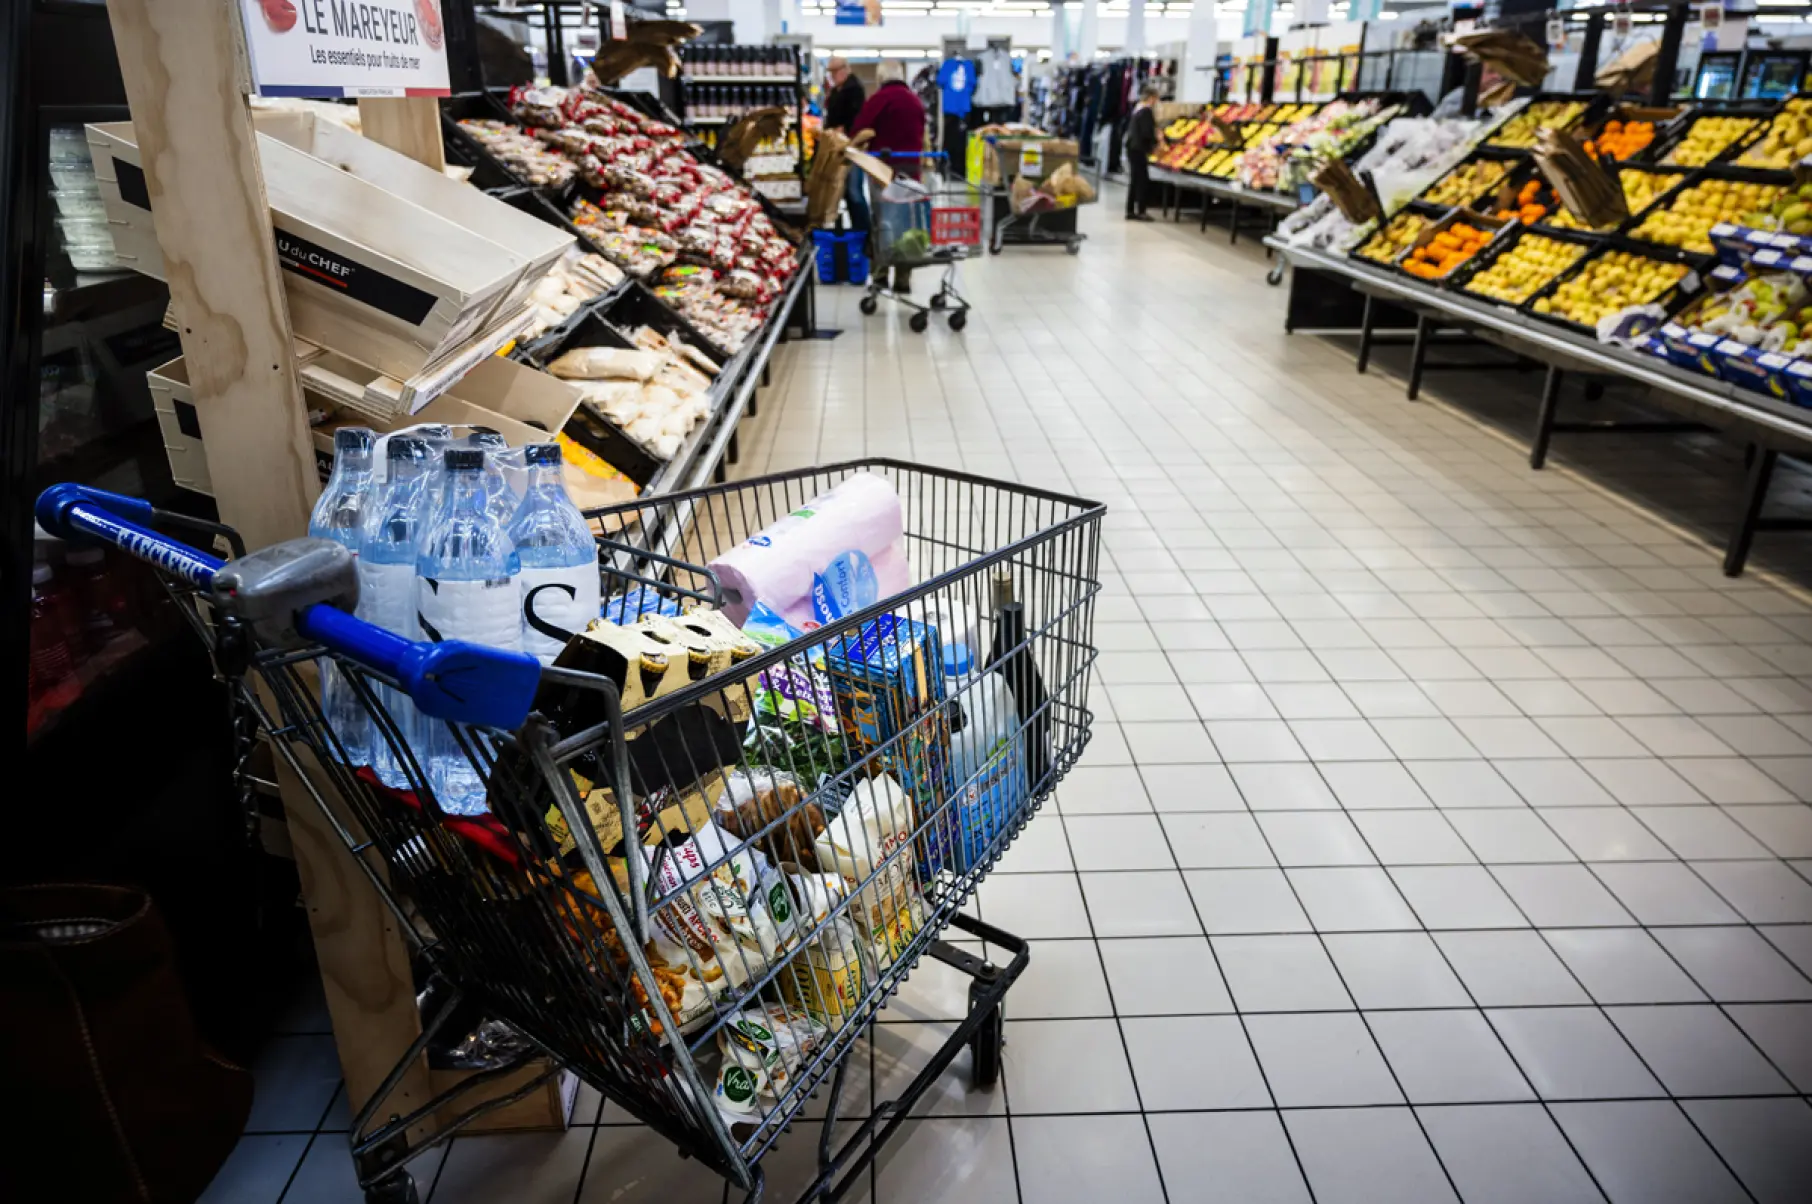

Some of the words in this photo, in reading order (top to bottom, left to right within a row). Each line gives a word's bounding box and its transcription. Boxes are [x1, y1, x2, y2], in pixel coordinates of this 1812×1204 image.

[302, 0, 328, 35] LE
[332, 0, 419, 46] MAREYEUR
[310, 45, 327, 64] Les
[328, 47, 366, 67] essentiels
[367, 53, 383, 71] pour
[384, 52, 400, 69] fruits
[401, 55, 409, 69] de
[409, 58, 421, 70] mer
[290, 247, 308, 260] du
